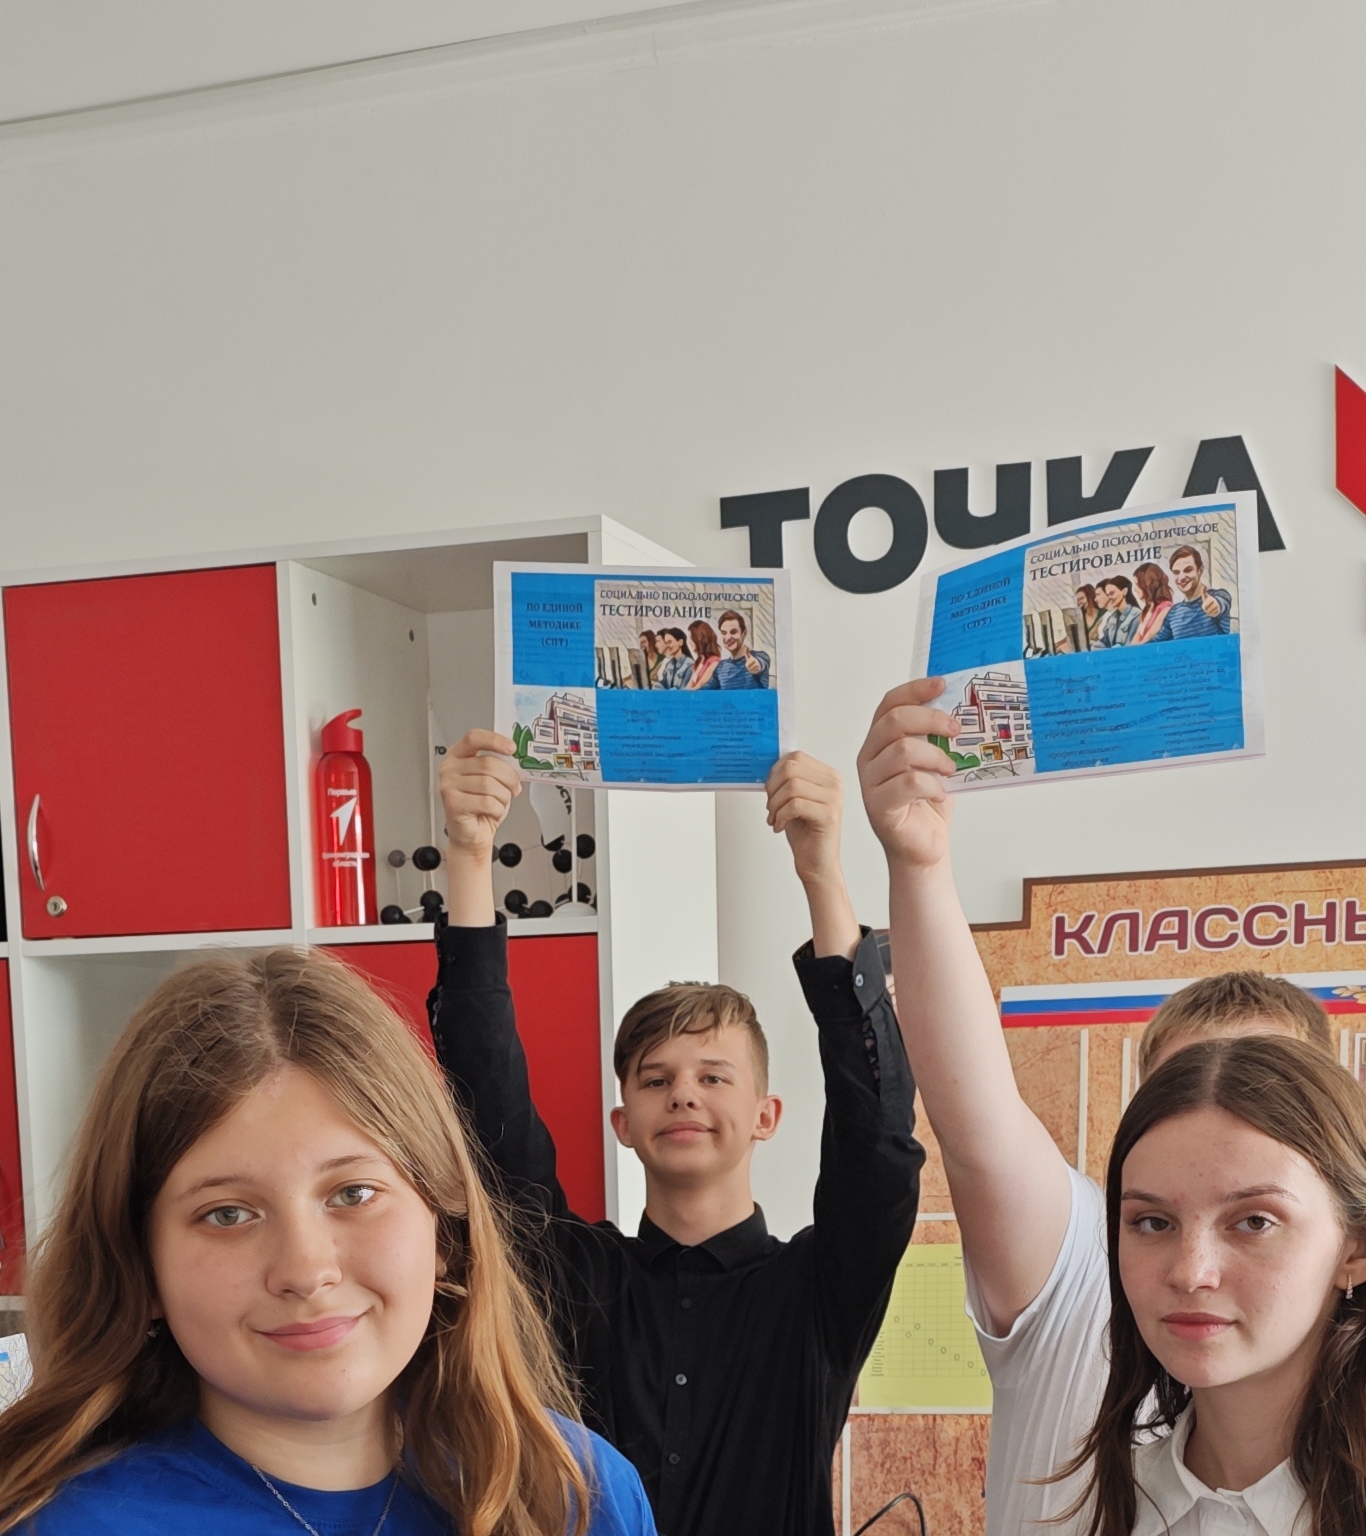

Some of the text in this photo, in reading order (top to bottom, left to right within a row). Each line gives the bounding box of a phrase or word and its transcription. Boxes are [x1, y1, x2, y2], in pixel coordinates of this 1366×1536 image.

[720, 435, 1286, 594] ТОЧКА
[1030, 522, 1219, 564] СОЦИАЛЬНО ПСИХОЛОГИЧЕСКОЕ
[1029, 545, 1162, 580] ТЕСТИРОВАНИЕ
[600, 590, 759, 603] СОЦИАЛЬНО ПСИХОЛОГИЧЕСКОЕ
[526, 601, 583, 613] ПО ЕДИНОЙ
[600, 604, 712, 618] ТЕСТИРОВАНИЕ
[528, 619, 581, 631] МЕТОДИКЕ
[541, 637, 569, 648] (СПТ)
